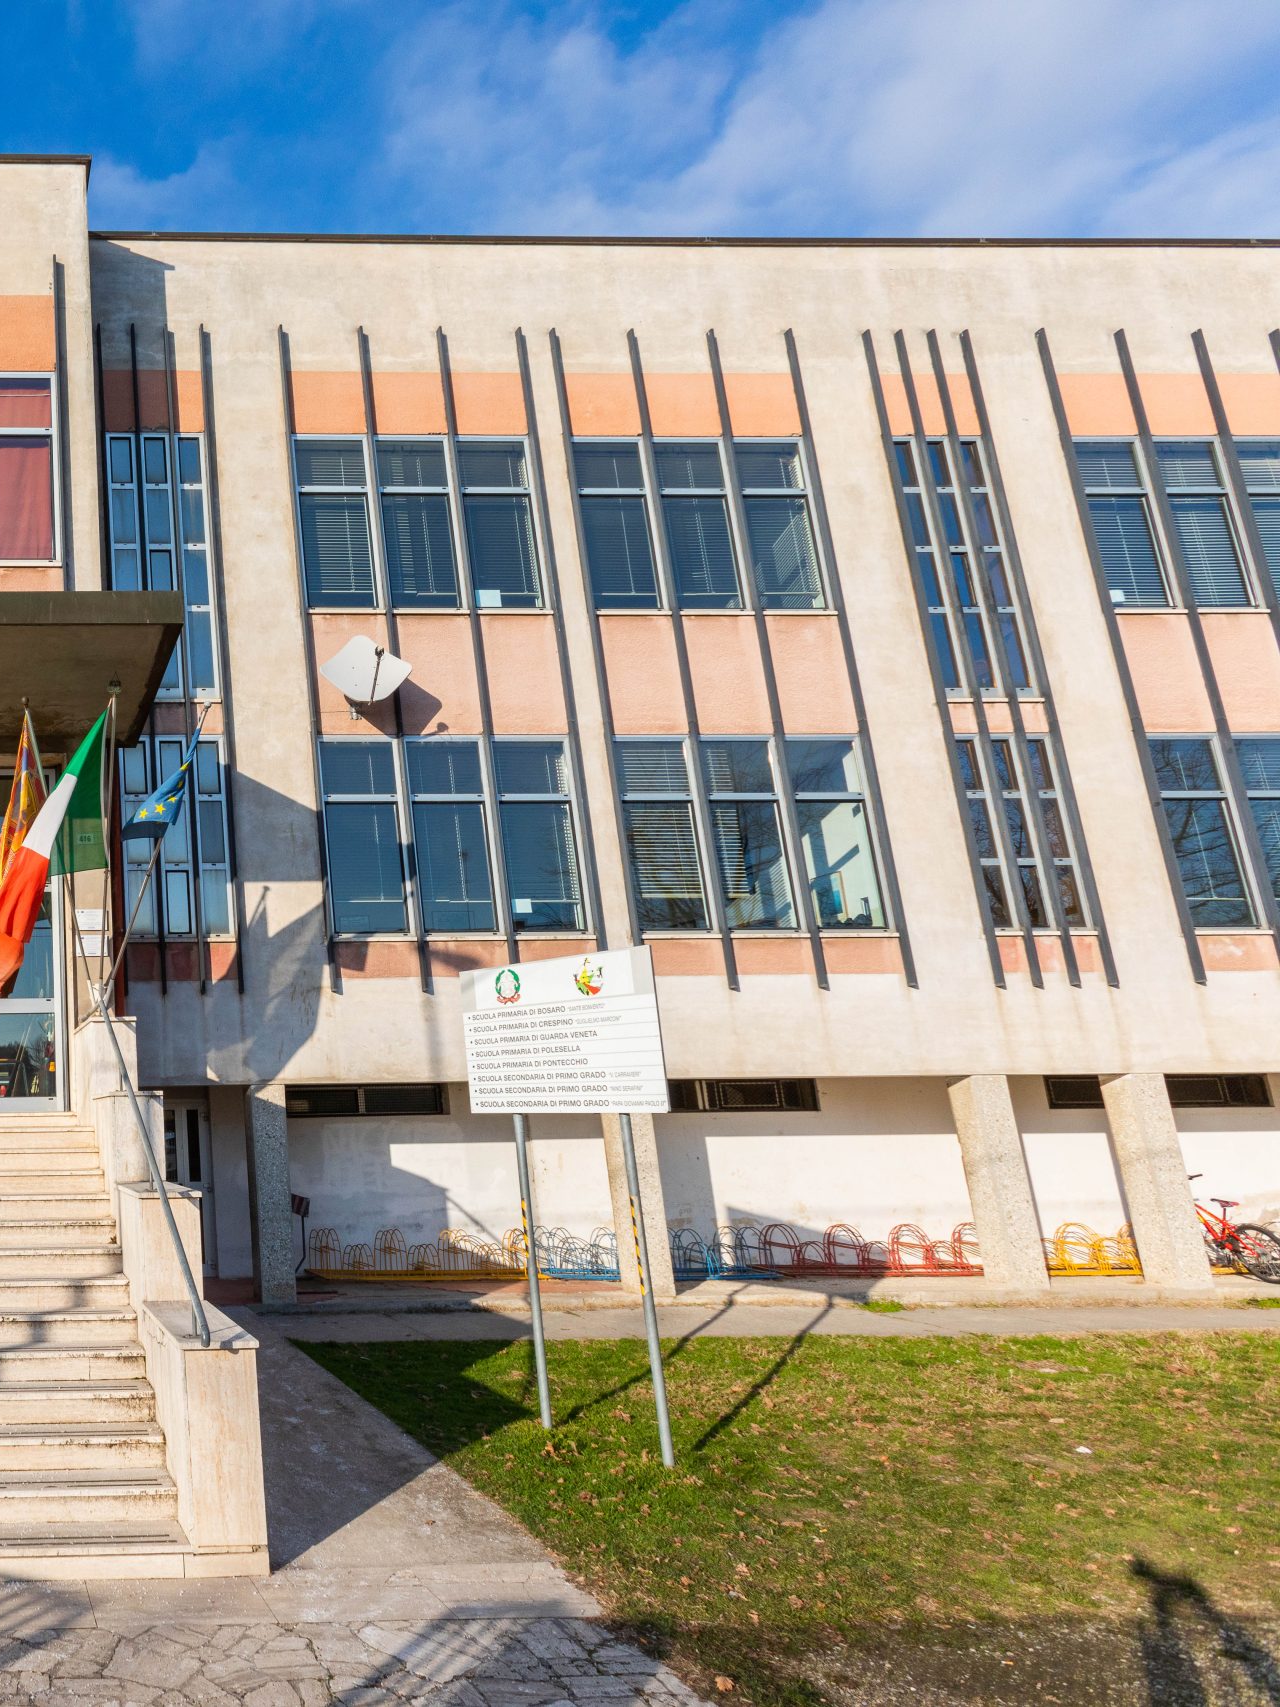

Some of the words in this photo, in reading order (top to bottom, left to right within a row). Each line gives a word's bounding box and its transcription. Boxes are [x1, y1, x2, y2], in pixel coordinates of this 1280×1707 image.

[472, 1013, 496, 1021] SCUOLA
[497, 1009, 528, 1018] PRIMARIA
[529, 1008, 536, 1016] DI
[537, 1005, 566, 1015] BOSARO
[473, 1025, 497, 1033] SCUOLA
[498, 1022, 529, 1031] PRIMARIA
[538, 1018, 574, 1028] CRESPINO
[474, 1037, 499, 1046] SCUOLA
[500, 1035, 530, 1044] PRIMARIA
[539, 1032, 569, 1041] GUARDA
[569, 1030, 598, 1039] VENETA
[475, 1050, 500, 1058] SCUOLA
[501, 1048, 532, 1056] PRIMARIA
[541, 1045, 581, 1054] POLESELLA
[476, 1062, 501, 1070] SCUOLA
[502, 1061, 533, 1069] PRIMARIA
[542, 1058, 589, 1067] PONTECCHIO
[477, 1075, 502, 1083] SCUOLA
[503, 1073, 545, 1082] SECONDARIA
[555, 1072, 579, 1080] PRIMO
[579, 1071, 607, 1079] GRADO
[478, 1087, 504, 1095] SCUOLA
[504, 1086, 547, 1094] SECONDARIA
[557, 1085, 580, 1093] PRIMO
[581, 1084, 608, 1092] GRADO
[480, 1100, 505, 1108] SCUOLA
[506, 1100, 548, 1108] SECONDARIA
[558, 1099, 581, 1107] PRIMO
[583, 1099, 610, 1107] GRADO
